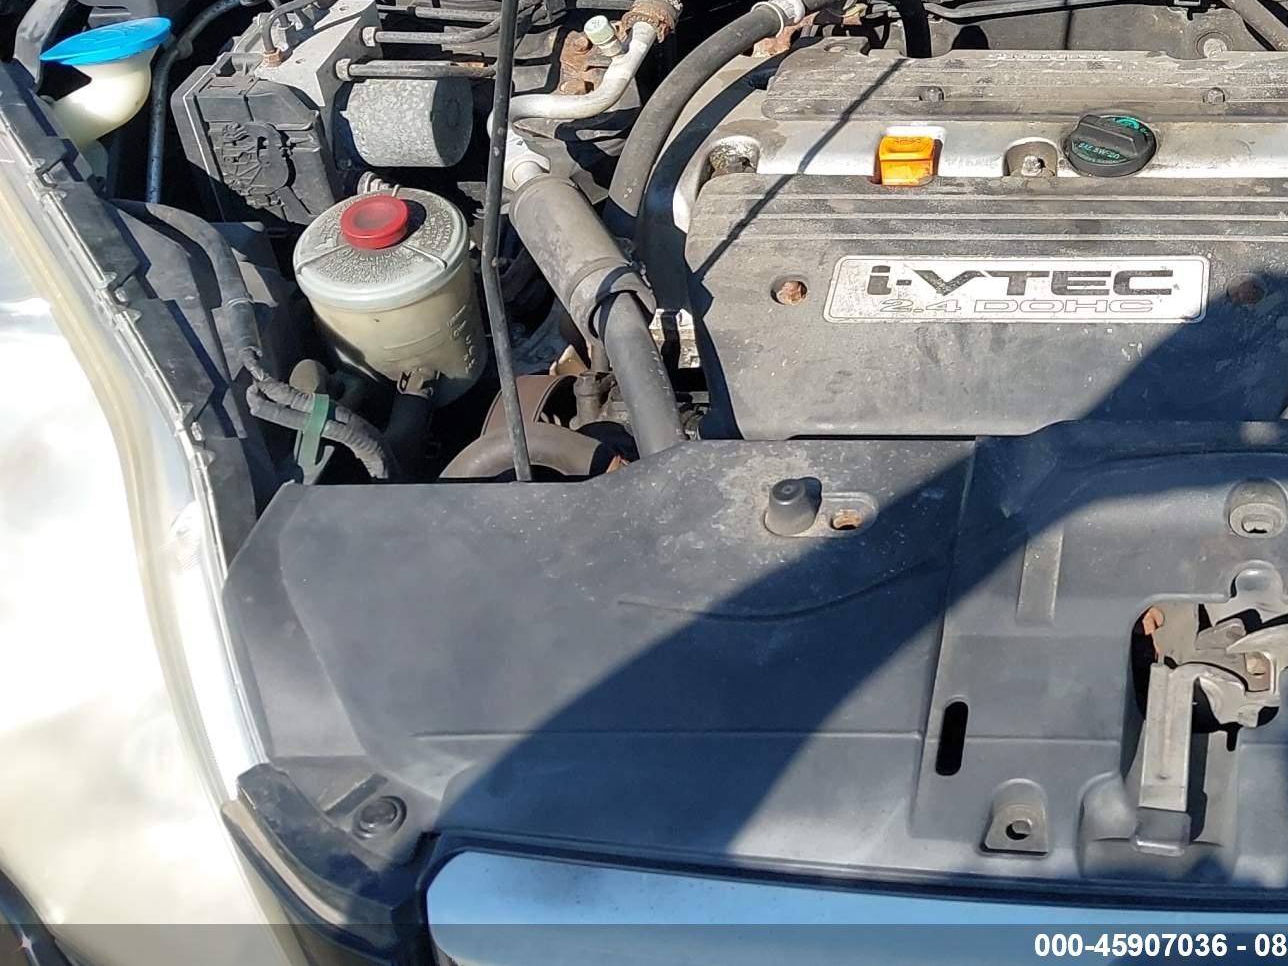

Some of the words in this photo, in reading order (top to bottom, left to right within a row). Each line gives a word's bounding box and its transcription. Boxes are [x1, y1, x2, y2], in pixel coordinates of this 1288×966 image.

[867, 265, 1175, 296] i-VTEC
[879, 298, 962, 313] 2.4
[973, 299, 1154, 314] DOHC
